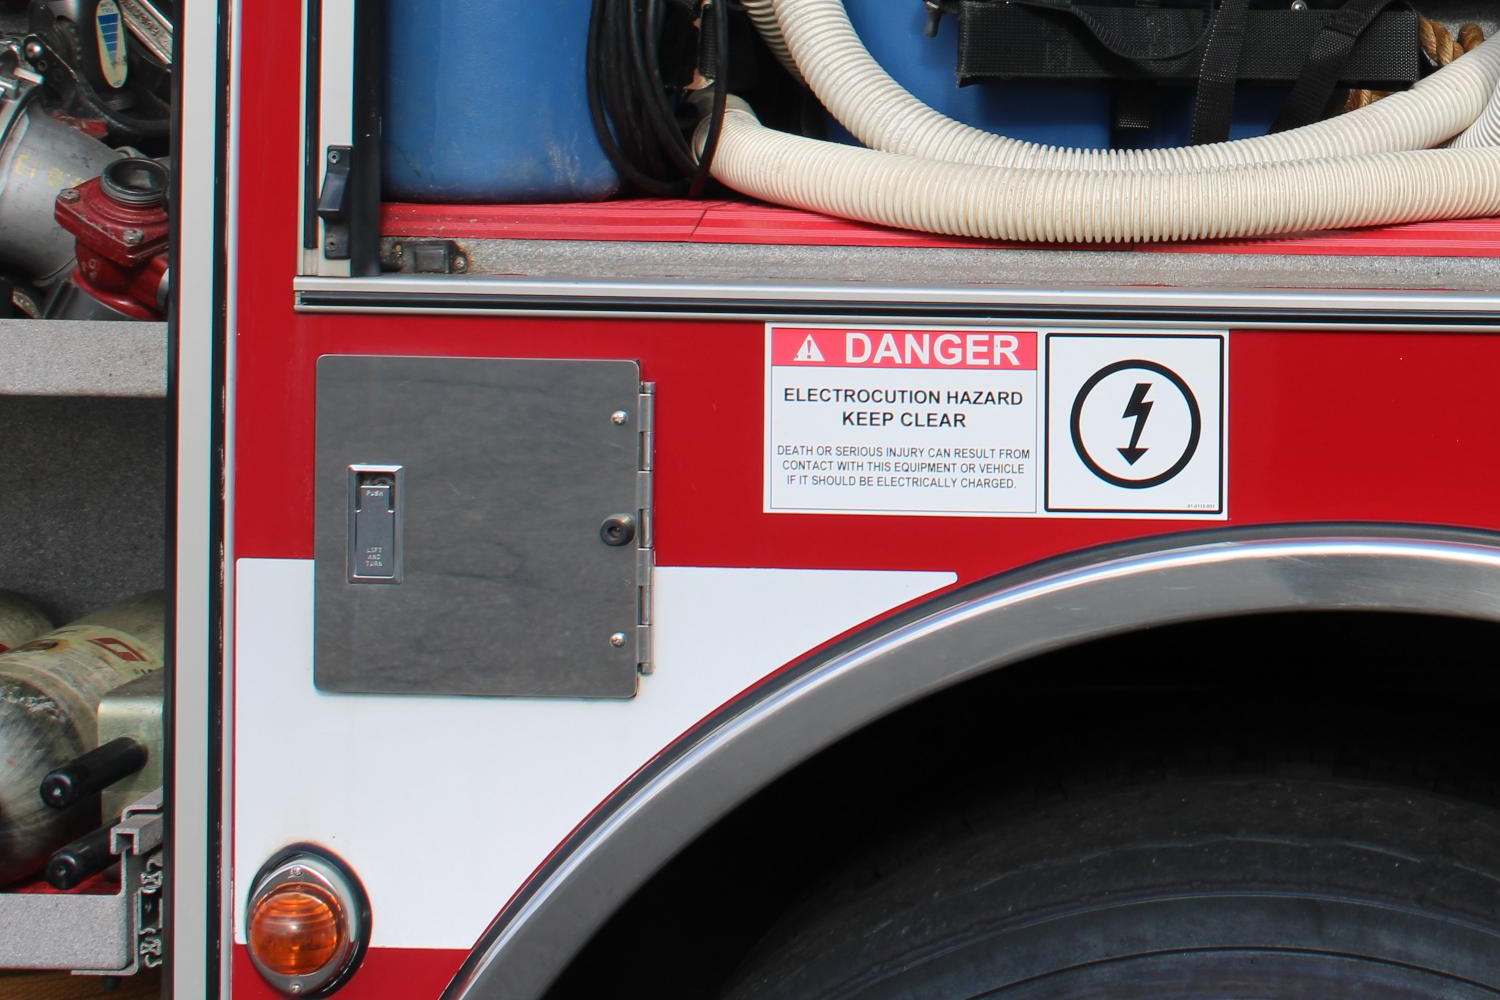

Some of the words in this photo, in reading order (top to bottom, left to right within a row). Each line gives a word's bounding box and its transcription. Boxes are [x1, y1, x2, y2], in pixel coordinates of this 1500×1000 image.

[845, 332, 1021, 366] DANGER
[784, 388, 940, 404] ELECTROCUTION
[947, 390, 1023, 405] HAZARD
[842, 411, 894, 426] KEEP
[900, 412, 966, 428] CLEAR
[777, 445, 814, 456] DEATH
[816, 446, 832, 456] OR
[835, 446, 883, 457] SERIOUS
[886, 447, 924, 458] INJURY
[927, 448, 951, 458] CAN
[953, 448, 996, 459] RESULT
[999, 449, 1030, 459] FROM
[782, 460, 834, 471] CONTACT
[837, 461, 864, 471] WITH
[867, 462, 892, 472] THIS
[894, 462, 957, 473] EQUIPMENT
[960, 463, 976, 473] OR
[979, 463, 1025, 474] VEHICLE
[787, 475, 796, 485] IF
[799, 475, 808, 485] IT
[812, 475, 856, 486] SHOULD
[859, 477, 874, 487] BE
[876, 477, 957, 488] ELECTRICALLY
[960, 478, 1017, 489] CHARGED.
